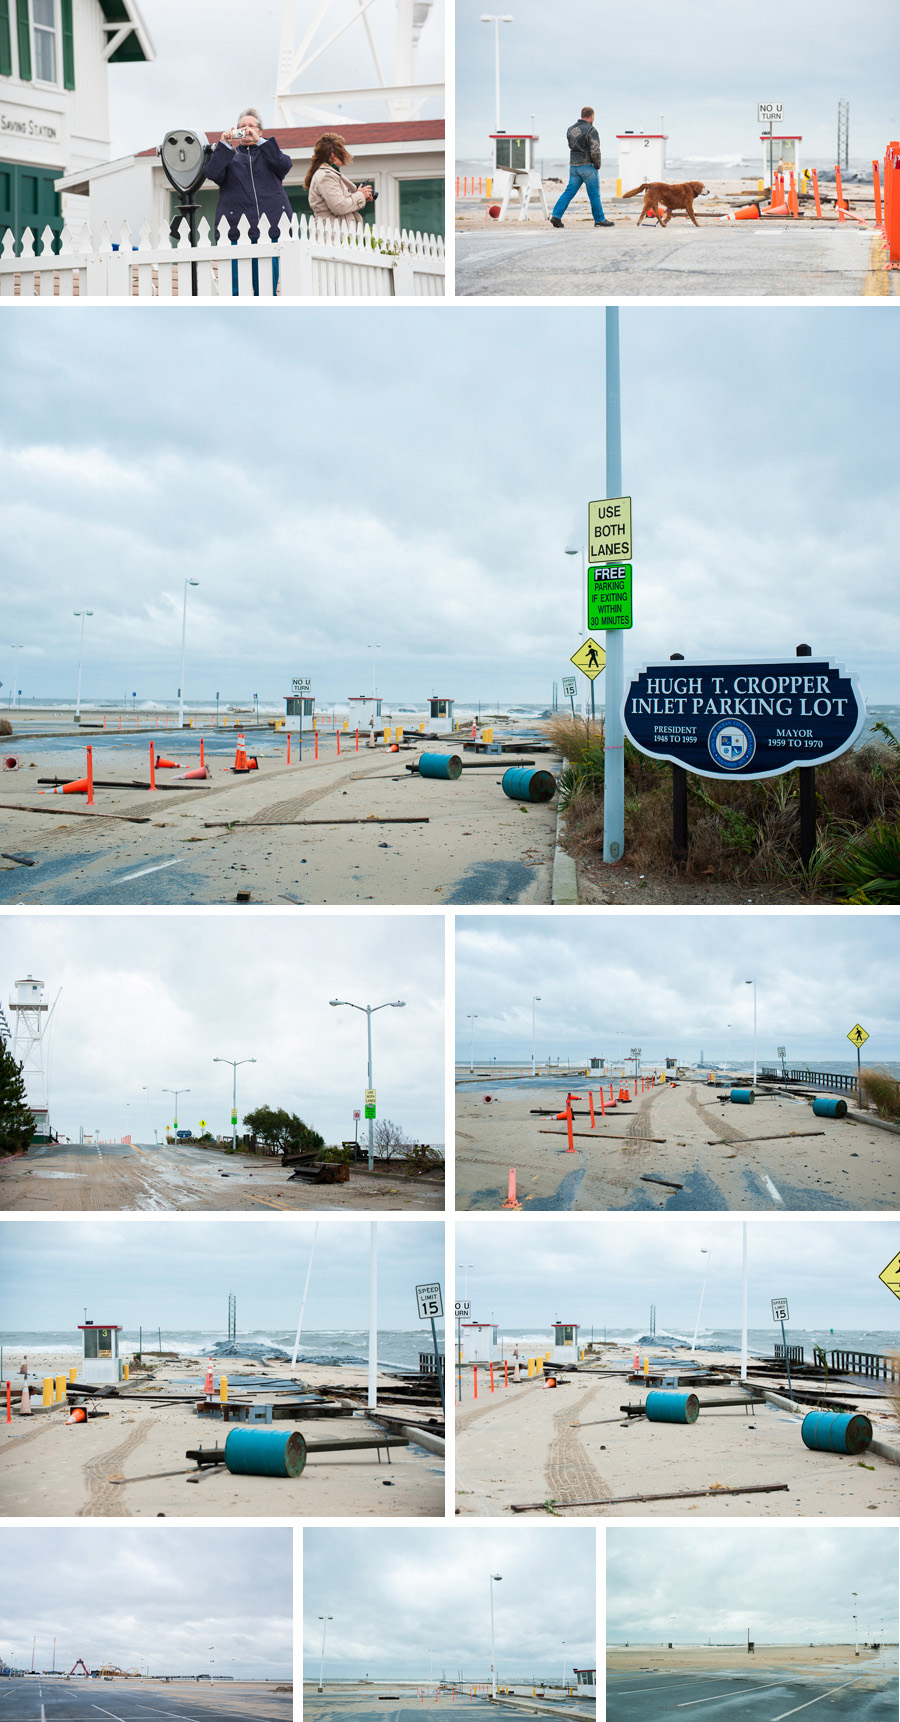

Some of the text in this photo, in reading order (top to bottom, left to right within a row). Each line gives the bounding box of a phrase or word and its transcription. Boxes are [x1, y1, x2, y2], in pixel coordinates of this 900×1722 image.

[760, 104, 783, 112] NO U
[29, 120, 56, 138] STATION
[516, 139, 521, 148] 1
[644, 140, 650, 148] 2
[785, 140, 792, 148] 3
[598, 505, 621, 519] USE
[594, 523, 626, 538] BOTH
[591, 542, 629, 556] LANES
[594, 566, 626, 580] FREE
[594, 581, 624, 591] PARKING
[592, 592, 628, 602] IF EXITING
[598, 604, 622, 614] WITHIN
[590, 616, 630, 626] 30 MINUTES
[566, 686, 575, 694] 15
[646, 676, 831, 694] HUGH T. CROPPER
[632, 698, 848, 716] INLET PARKING LOT
[654, 726, 697, 734] PRESIDENT
[776, 729, 814, 738] MAYOR
[669, 735, 681, 743] TO
[682, 736, 698, 744] 1959
[768, 739, 823, 748] 1959 TO 1970
[418, 1286, 439, 1294] SPEED
[422, 1301, 439, 1315] 15
[775, 1310, 786, 1319] 15
